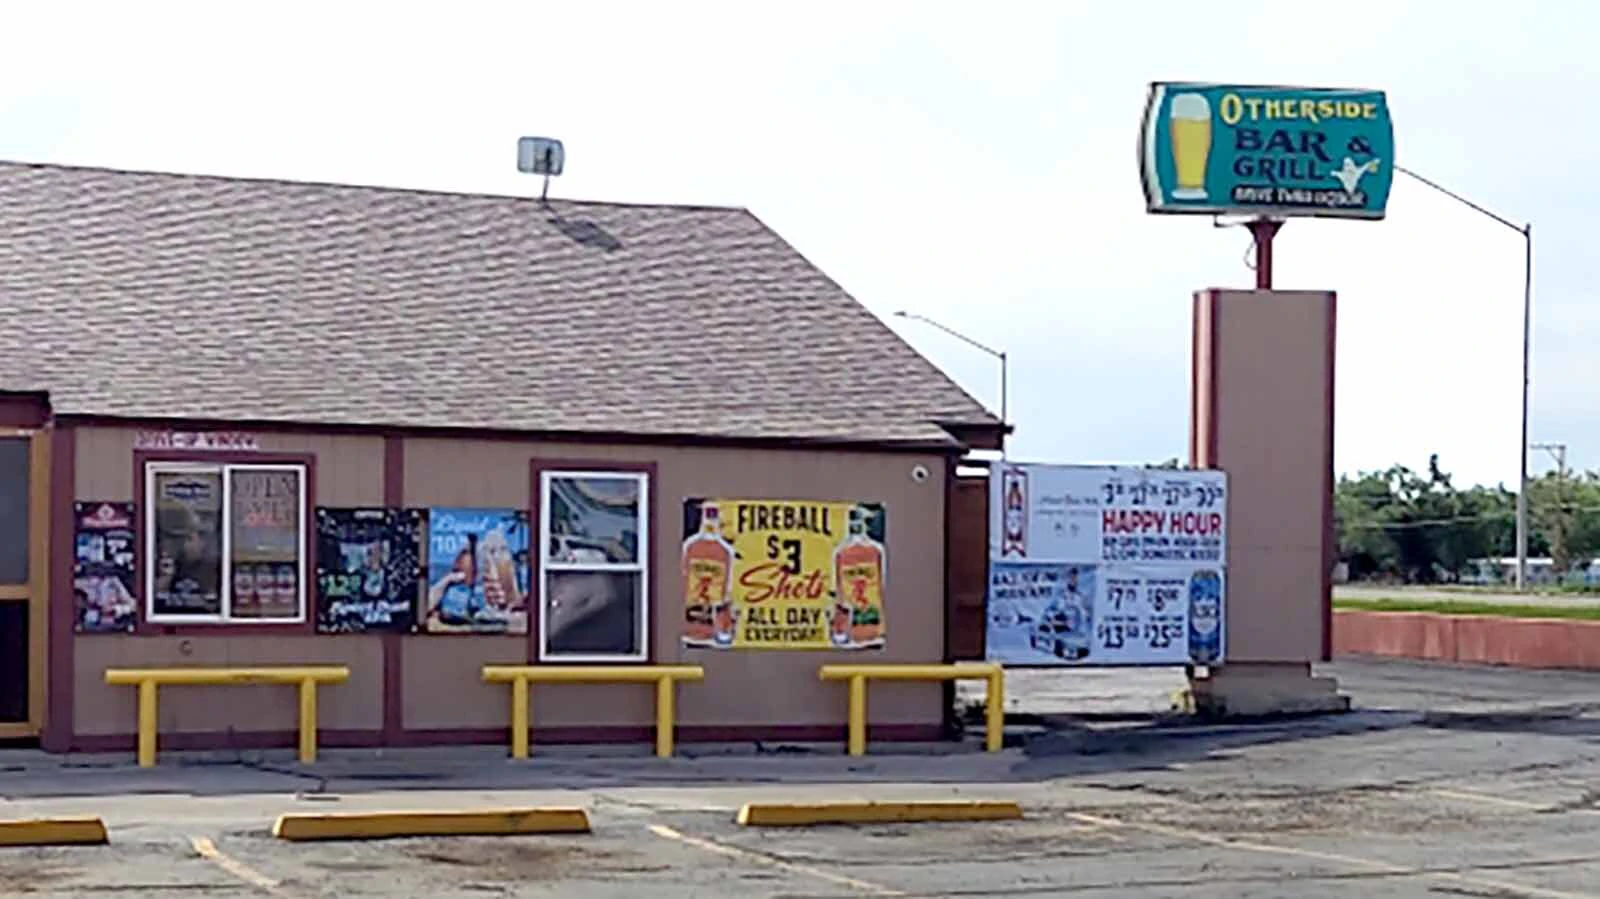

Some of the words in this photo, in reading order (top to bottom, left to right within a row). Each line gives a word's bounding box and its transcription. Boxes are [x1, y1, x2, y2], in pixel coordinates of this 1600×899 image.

[1219, 93, 1377, 124] OTHERSIDE
[1233, 129, 1331, 161] BAR
[1347, 136, 1376, 156] &
[1232, 156, 1324, 182] GRILL
[738, 504, 831, 536] FIREBALL
[1103, 510, 1166, 534] HAPPY
[1170, 511, 1221, 535] HOUR
[739, 562, 823, 604] Shots
[747, 607, 778, 625] ALL
[787, 607, 821, 625] DAY
